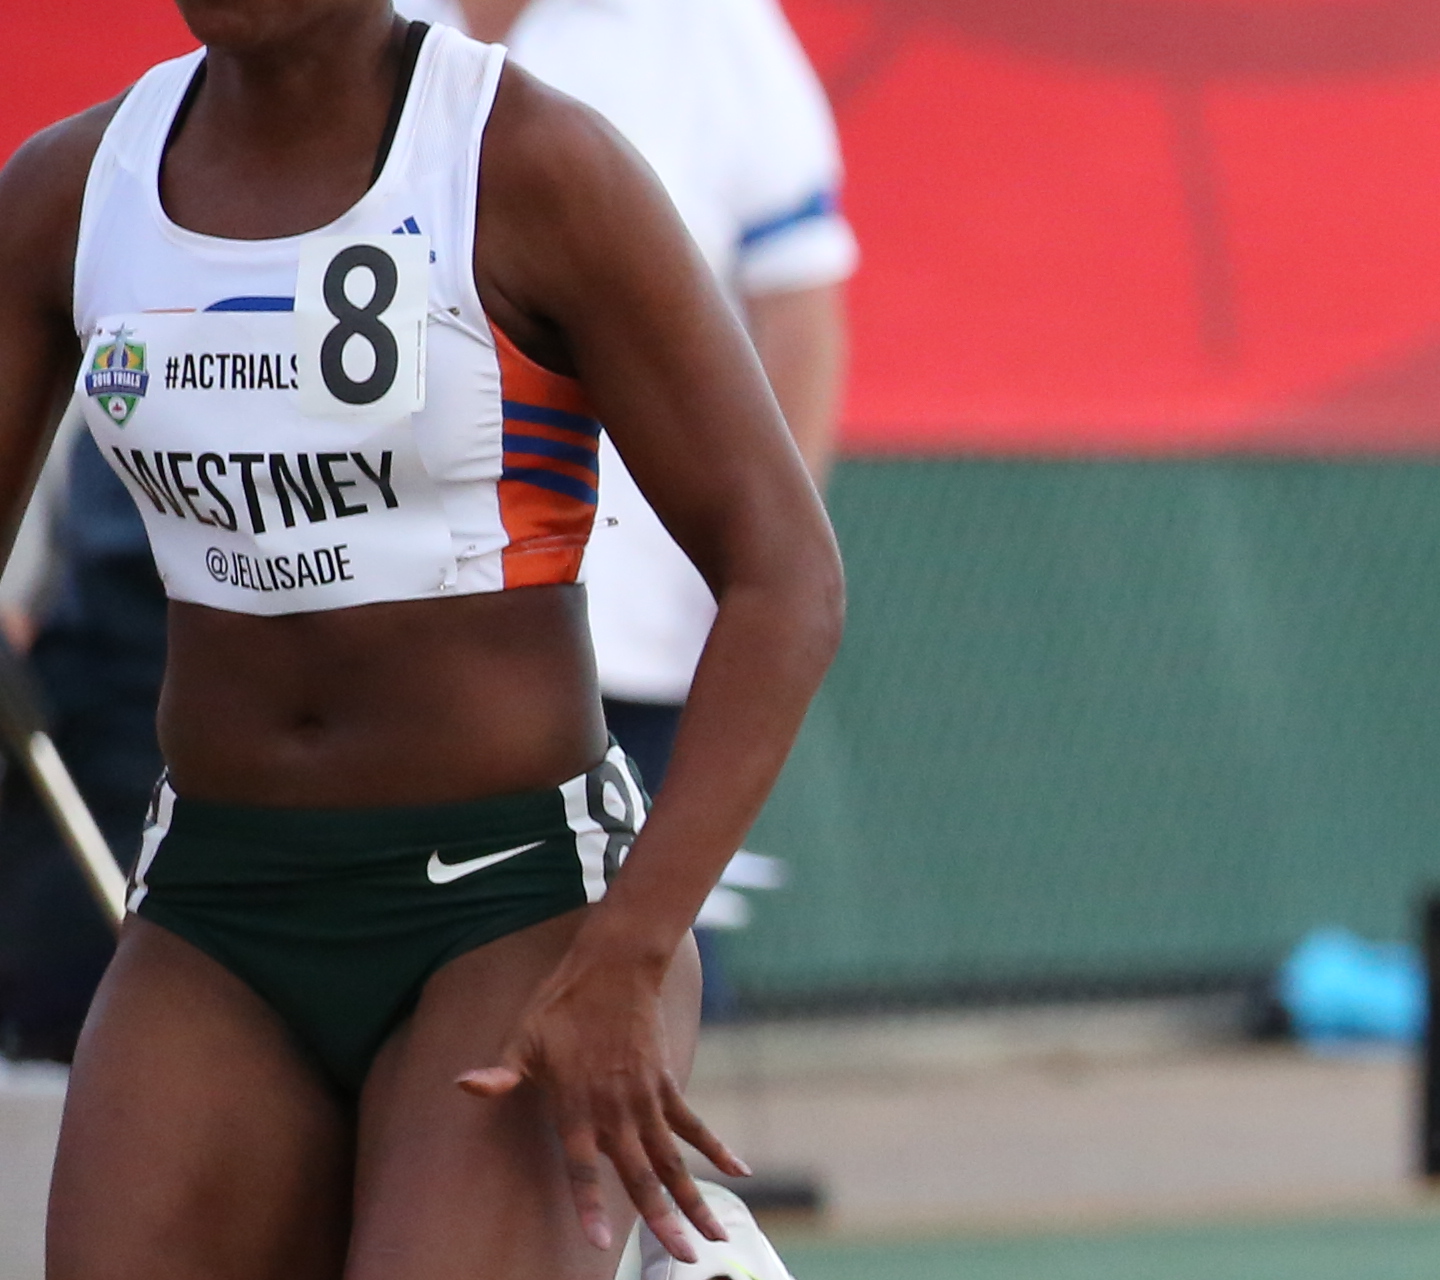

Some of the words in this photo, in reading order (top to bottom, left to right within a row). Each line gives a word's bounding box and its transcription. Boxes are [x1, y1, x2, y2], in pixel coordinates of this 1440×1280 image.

[320, 245, 398, 404] 8
[113, 371, 140, 388] TRIALS
[112, 447, 399, 533] WESTNEY
[206, 544, 354, 592] @JELLISADE
